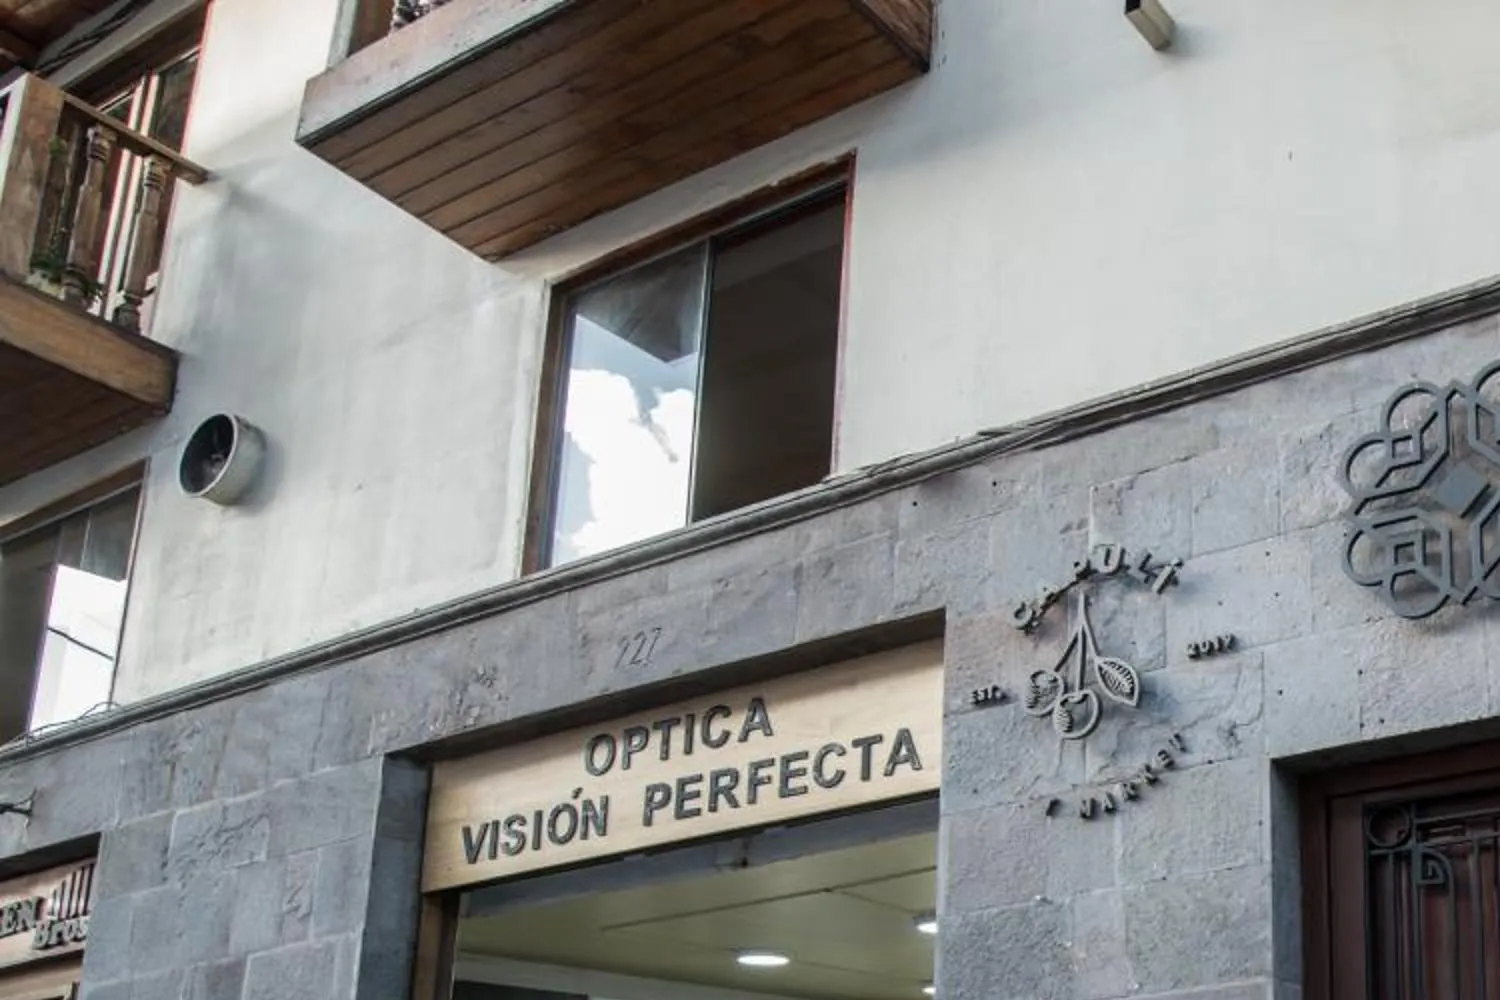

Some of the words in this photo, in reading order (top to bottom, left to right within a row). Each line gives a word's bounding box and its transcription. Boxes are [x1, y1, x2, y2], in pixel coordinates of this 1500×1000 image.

[584, 697, 773, 776] OPTICA
[461, 787, 608, 865] VISIÓN
[643, 727, 923, 826] PERFECTA
